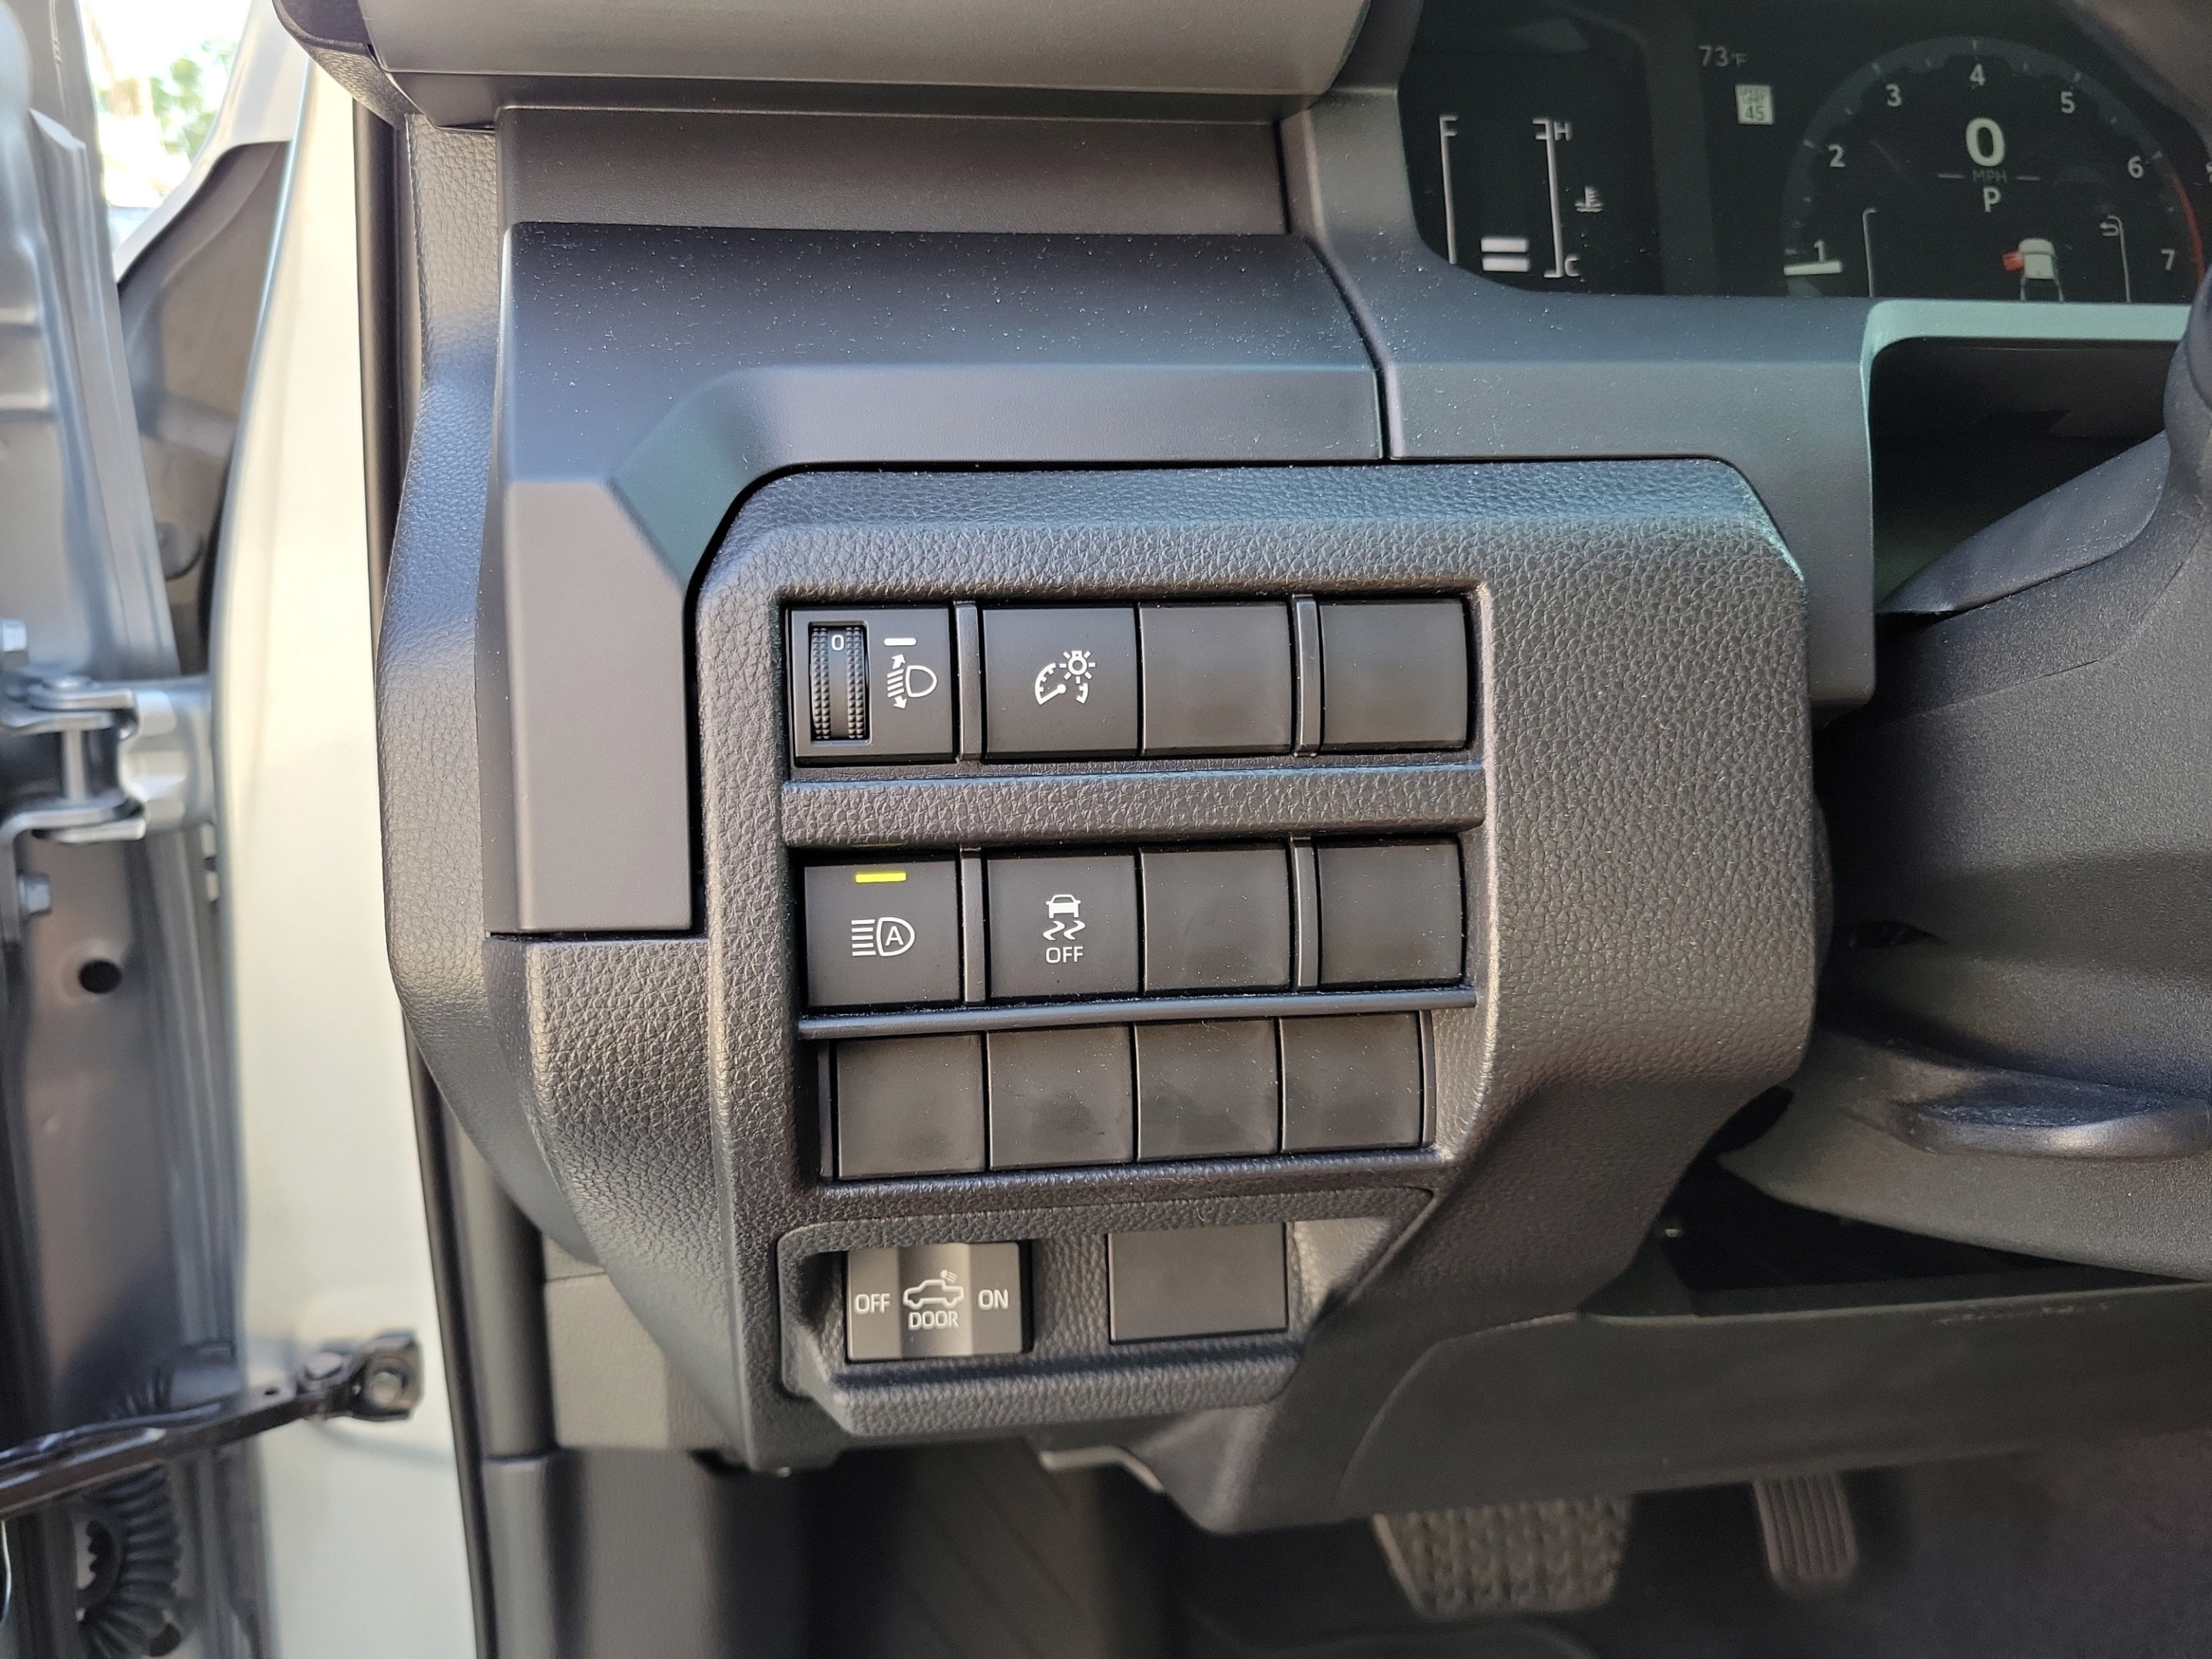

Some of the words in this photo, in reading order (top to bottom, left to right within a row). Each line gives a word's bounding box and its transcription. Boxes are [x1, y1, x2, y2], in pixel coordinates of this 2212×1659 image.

[1969, 63, 1985, 86] 4
[1886, 84, 1902, 107] 3
[2061, 91, 2075, 114] 5
[1745, 105, 1765, 121] 45
[1554, 121, 1572, 141] H
[1965, 118, 2005, 167] 0
[1829, 144, 1846, 167] 2
[2128, 155, 2144, 178] 6
[1982, 186, 2002, 213] P
[1813, 239, 1825, 262] 1
[2161, 249, 2175, 270] 7
[1564, 253, 1581, 277] C
[885, 926, 905, 947] A
[1045, 946, 1084, 965] OFF
[854, 1293, 891, 1315] OFF
[978, 1288, 1009, 1310] ON
[908, 1310, 959, 1331] DOOR
